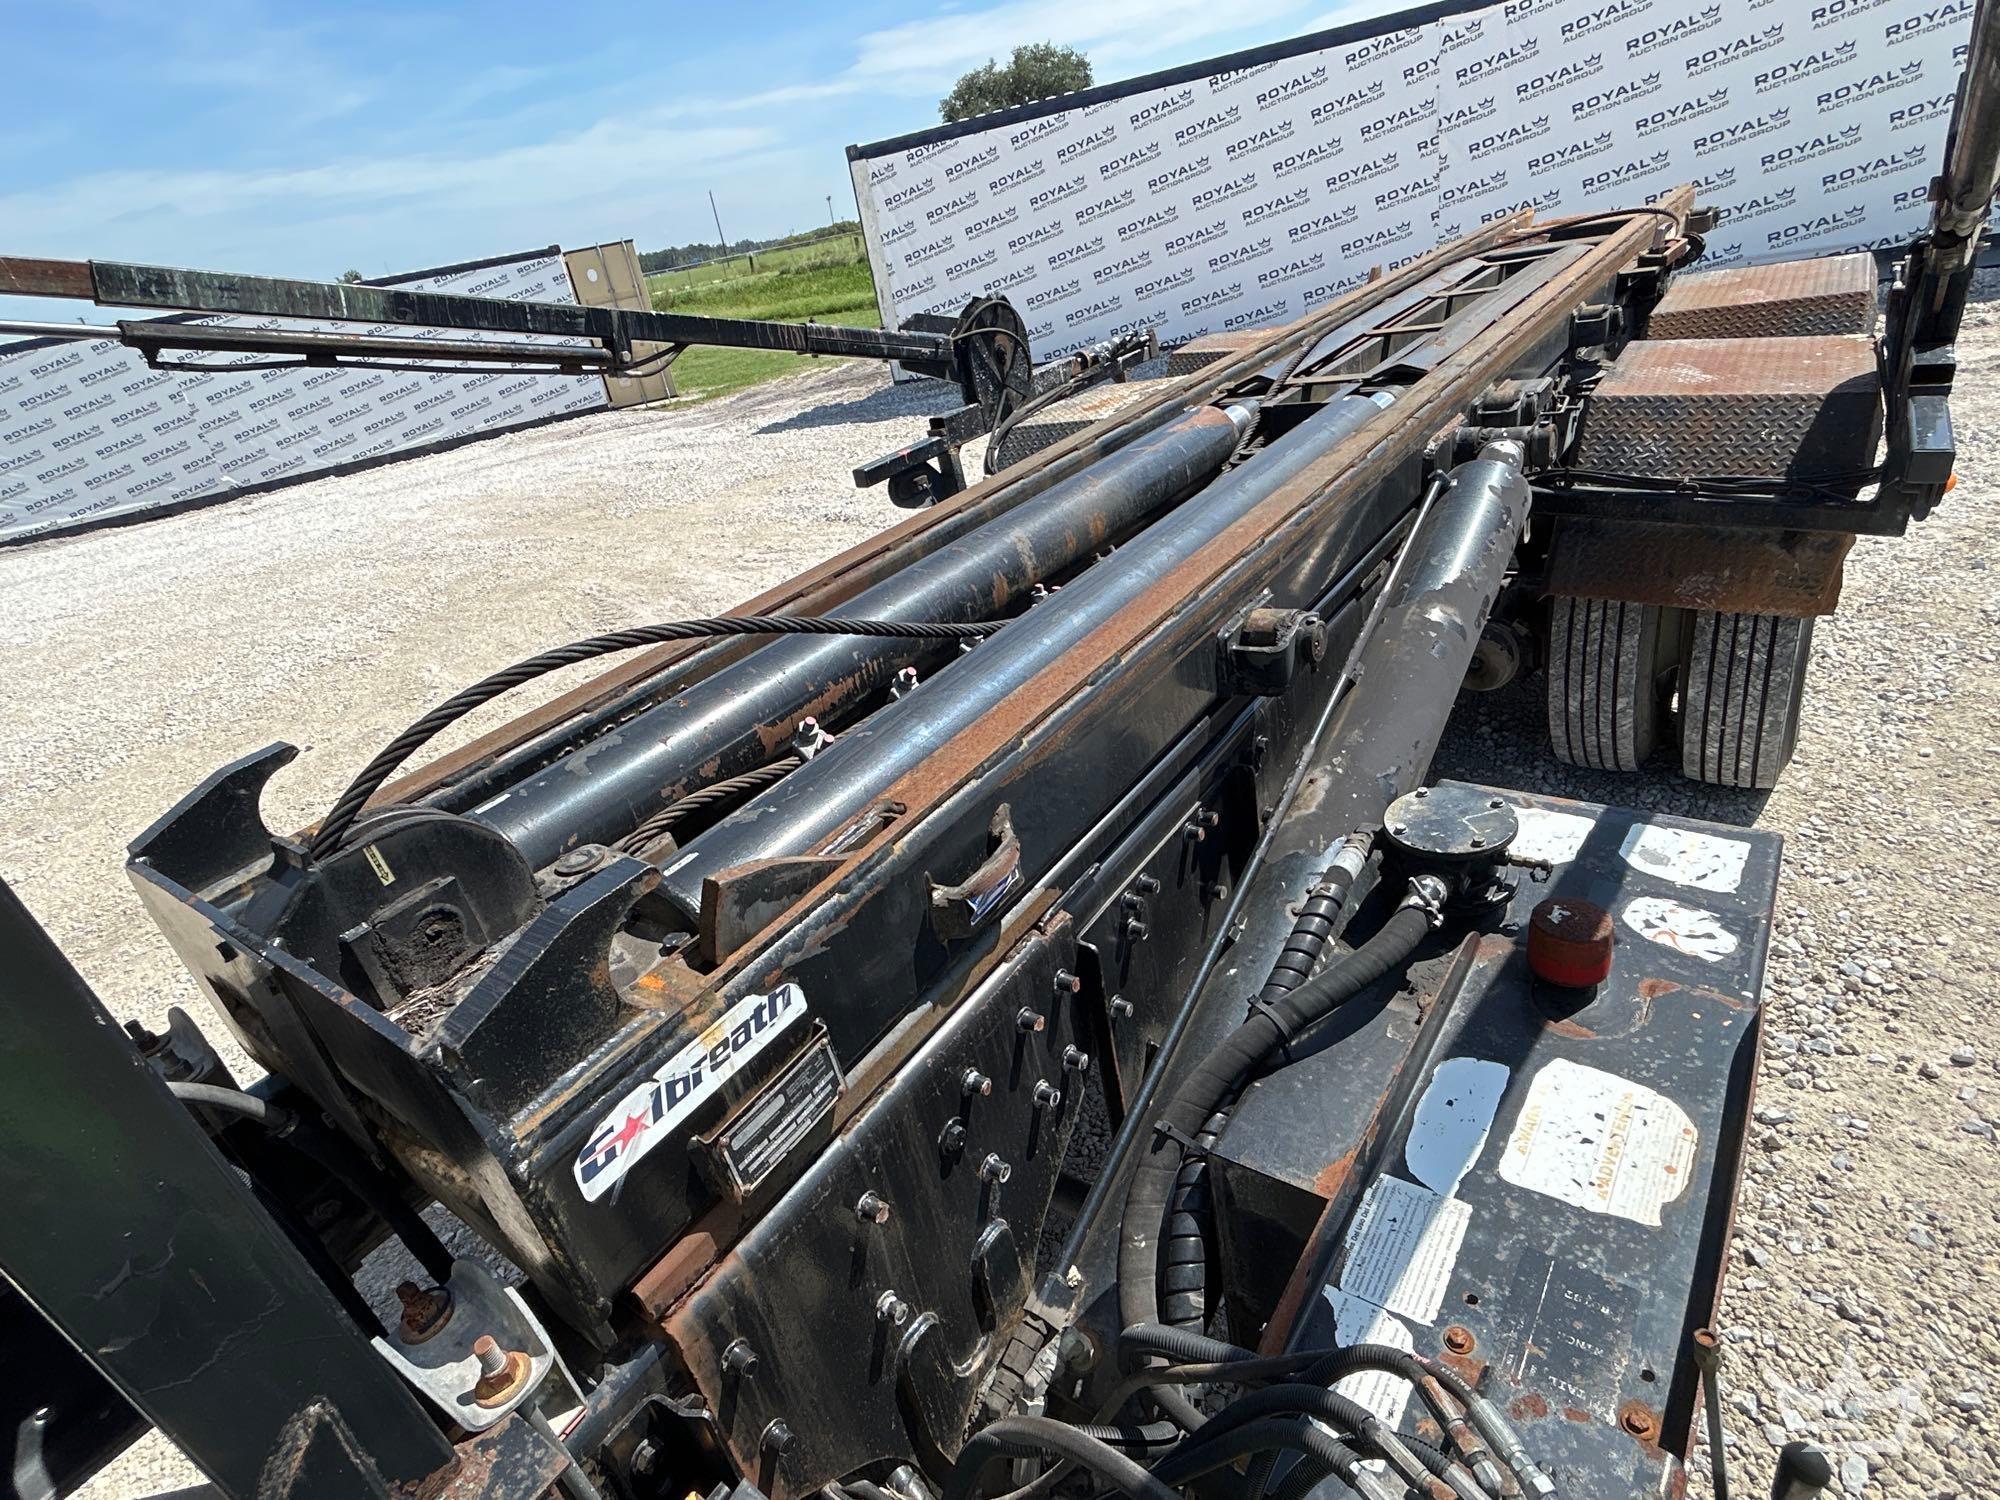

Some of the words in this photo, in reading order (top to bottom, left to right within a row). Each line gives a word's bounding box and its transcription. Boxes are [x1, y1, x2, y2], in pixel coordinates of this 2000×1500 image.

[1561, 1, 1631, 36] ROYAL
[1563, 21, 1611, 45] AUCTION
[1613, 2, 1653, 23] GROUP
[1628, 16, 1700, 50] ROYAL
[1629, 35, 1679, 59] AUCTION
[1679, 18, 1721, 37] GROUP
[1456, 48, 1520, 80] ROYAL
[1687, 35, 1761, 69] ROYAL
[1689, 54, 1740, 77] AUCTION
[1740, 37, 1783, 56] GROUP
[1458, 65, 1503, 87] AUCTION
[1502, 50, 1540, 68] GROUP
[1517, 63, 1583, 95] ROYAL
[1756, 51, 1833, 86] ROYAL
[1757, 70, 1811, 94] AUCTION
[1811, 53, 1856, 73] GROUP
[1257, 75, 1312, 104] ROYAL
[1260, 91, 1297, 111] AUCTION
[1296, 77, 1327, 93] GROUP
[1519, 81, 1565, 103] AUCTION
[1564, 65, 1603, 83] GROUP
[1819, 71, 1898, 105] ROYAL
[1820, 90, 1875, 114] AUCTION
[1875, 73, 1922, 93] GROUP
[1130, 97, 1179, 124] ROYAL
[1311, 90, 1368, 119] ROYAL
[1314, 106, 1353, 126] AUCTION
[1352, 92, 1384, 108] GROUP
[1573, 82, 1641, 114] ROYAL
[1574, 99, 1622, 121] AUCTION
[1621, 84, 1661, 102] GROUP
[1134, 113, 1167, 131] AUCTION
[1166, 99, 1193, 115] GROUP
[1175, 113, 1226, 141] ROYAL
[1361, 107, 1419, 136] ROYAL
[1364, 124, 1403, 143] AUCTION
[1403, 109, 1436, 126] GROUP
[1637, 98, 1707, 130] ROYAL
[1638, 116, 1687, 138] AUCTION
[1687, 100, 1728, 118] GROUP
[1179, 129, 1213, 147] AUCTION
[1212, 116, 1240, 131] GROUP
[1226, 128, 1279, 155] ROYAL
[1469, 124, 1532, 154] ROYAL
[1471, 141, 1514, 161] AUCTION
[1514, 126, 1551, 143] GROUP
[1695, 117, 1768, 149] ROYAL
[1696, 135, 1747, 157] AUCTION
[1747, 120, 1790, 138] GROUP
[1057, 133, 1103, 158] ROYAL
[1061, 148, 1091, 165] AUCTION
[1090, 135, 1116, 150] GROUP
[1230, 143, 1265, 162] AUCTION
[1264, 130, 1294, 146] GROUP
[1273, 145, 1327, 172] ROYAL
[1528, 140, 1594, 170] ROYAL
[1763, 134, 1838, 166] ROYAL
[1764, 152, 1816, 174] AUCTION
[1816, 137, 1861, 155] GROUP
[945, 153, 987, 177] ROYAL
[949, 167, 977, 183] AUCTION
[976, 155, 999, 169] GROUP
[1276, 160, 1313, 179] AUCTION
[1312, 147, 1343, 163] GROUP
[1326, 160, 1382, 187] ROYAL
[1530, 157, 1575, 177] AUCTION
[1575, 143, 1613, 160] GROUP
[1824, 154, 1902, 186] ROYAL
[989, 166, 1032, 190] ROYAL
[993, 180, 1021, 196] AUCTION
[1020, 169, 1044, 182] GROUP
[1329, 176, 1367, 194] AUCTION
[1367, 163, 1398, 178] GROUP
[1583, 159, 1650, 189] ROYAL
[1584, 176, 1631, 196] AUCTION
[1631, 162, 1670, 179] GROUP
[1825, 172, 1879, 194] AUCTION
[1879, 157, 1925, 175] GROUP
[885, 184, 923, 206] ROYAL
[889, 197, 914, 212] AUCTION
[913, 186, 934, 199] GROUP
[1192, 180, 1242, 205] ROYAL
[1196, 194, 1230, 211] AUCTION
[1229, 182, 1257, 197] GROUP
[926, 197, 966, 220] ROYAL
[930, 210, 957, 225] AUCTION
[956, 200, 978, 212] GROUP
[1076, 196, 1121, 220] ROYAL
[1079, 210, 1110, 226] AUCTION
[1109, 199, 1134, 212] GROUP
[1289, 212, 1342, 237] ROYAL
[1292, 227, 1328, 244] AUCTION
[1327, 215, 1357, 229] GROUP
[1769, 214, 1843, 243] ROYAL
[1770, 230, 1822, 250] AUCTION
[1821, 216, 1865, 233] GROUP
[1165, 227, 1213, 250] ROYAL
[1169, 241, 1201, 257] AUCTION
[1200, 230, 1227, 243] GROUP
[1341, 228, 1396, 253] ROYAL
[1344, 243, 1381, 259] AUCTION
[1381, 231, 1412, 245] GROUP
[1258, 260, 1309, 283] ROYAL
[1261, 273, 1296, 289] AUCTION
[1295, 263, 1324, 276] GROUP
[30, 358, 70, 375] ROYAL
[79, 366, 118, 383] ROYAL
[123, 376, 160, 392] ROYAL
[206, 385, 242, 401] ROYAL
[340, 379, 373, 395] ROYAL
[379, 386, 411, 401] ROYAL
[498, 380, 529, 395] ROYAL
[531, 388, 560, 403] ROYAL
[19, 390, 59, 407] ROYAL
[64, 399, 103, 416] ROYAL
[250, 392, 284, 408] ROYAL
[288, 401, 322, 417] ROYAL
[414, 394, 446, 409] ROYAL
[451, 401, 482, 416] ROYAL
[111, 406, 149, 423] ROYAL
[154, 415, 190, 432] ROYAL
[328, 408, 361, 423] ROYAL
[364, 416, 396, 431] ROYAL
[484, 409, 514, 424] ROYAL
[52, 430, 91, 447] ROYAL
[234, 423, 269, 439] ROYAL
[276, 430, 310, 446] ROYAL
[402, 422, 434, 437] ROYAL
[96, 439, 134, 455] ROYAL
[142, 445, 178, 462] ROYAL
[313, 438, 346, 453] ROYAL
[37, 463, 76, 480] ROYAL
[223, 453, 257, 469] ROYAL
[261, 460, 295, 476] ROYAL
[85, 469, 122, 486] ROYAL
[127, 477, 163, 493] ROYAL
[26, 494, 64, 511] ROYAL
[69, 501, 107, 518] ROYAL
